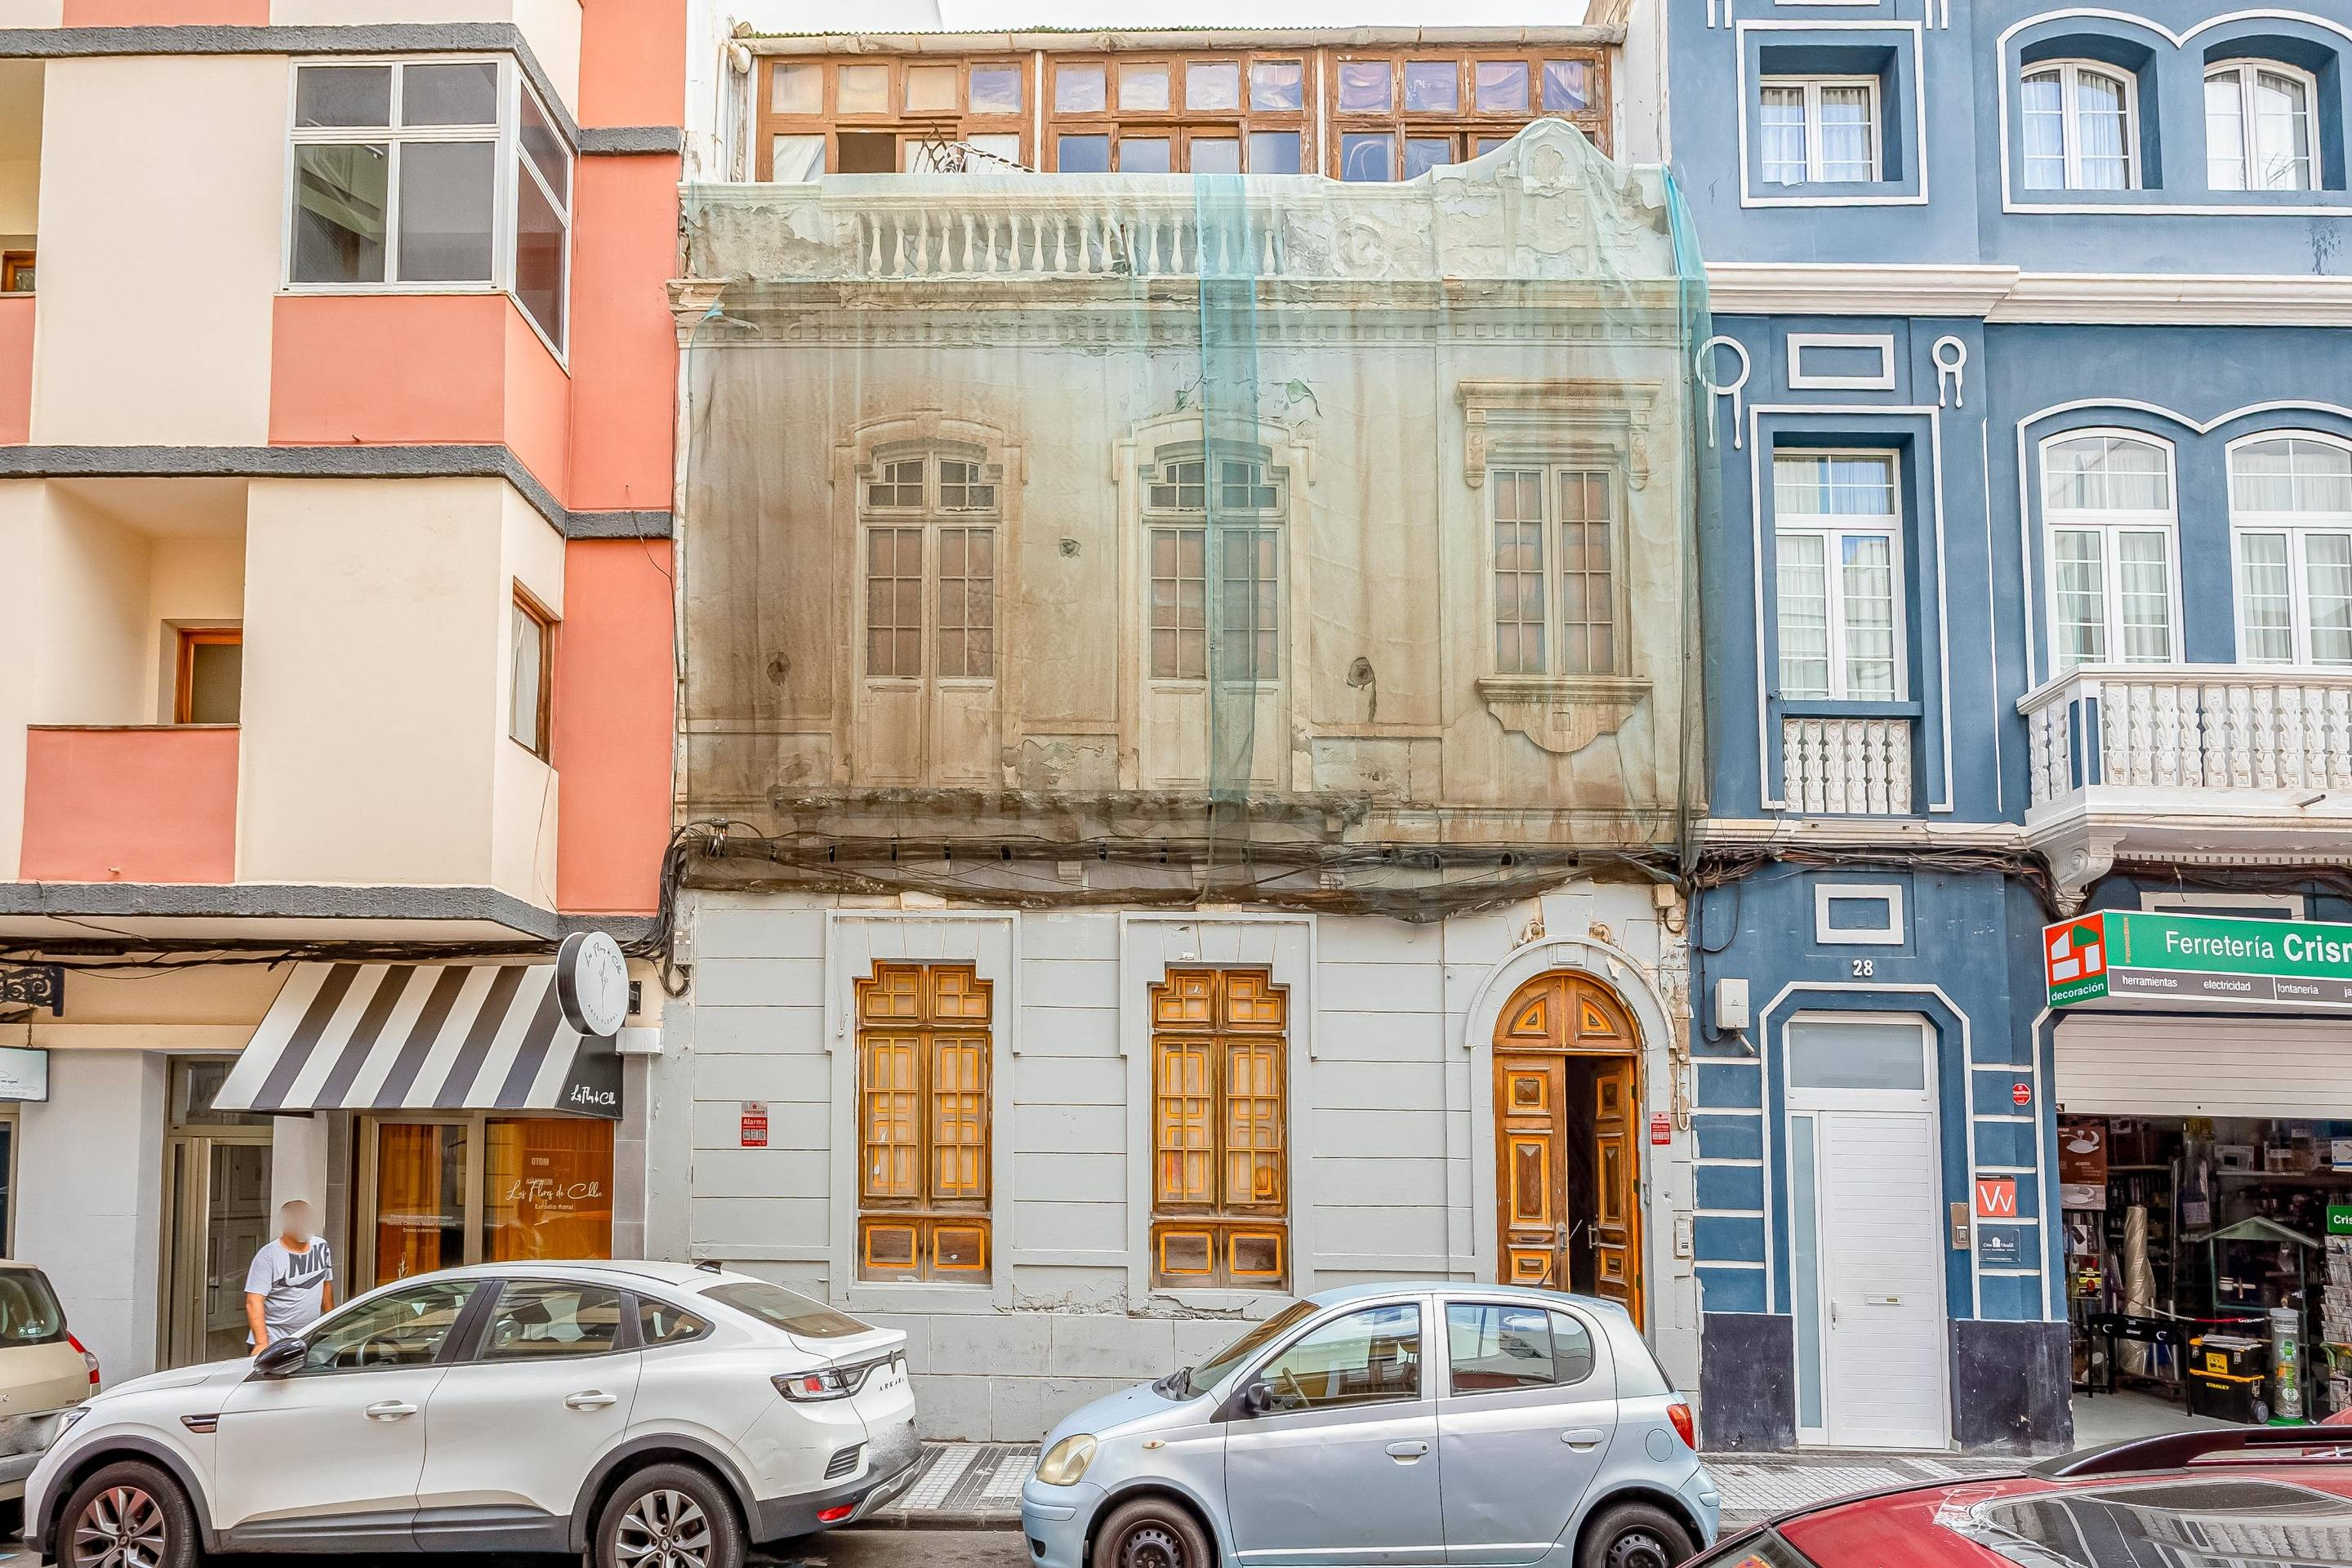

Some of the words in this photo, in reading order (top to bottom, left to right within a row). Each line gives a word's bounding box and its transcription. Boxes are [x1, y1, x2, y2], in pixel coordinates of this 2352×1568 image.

[2165, 930, 2274, 959] Ferretería
[1853, 959, 1873, 977] 28
[2123, 974, 2178, 987] herramientas
[2203, 979, 2252, 991] electricidad
[2051, 982, 2105, 1001] decoración
[506, 1179, 527, 1200] Las
[556, 1183, 564, 1199] de
[288, 1242, 331, 1278] NIKE
